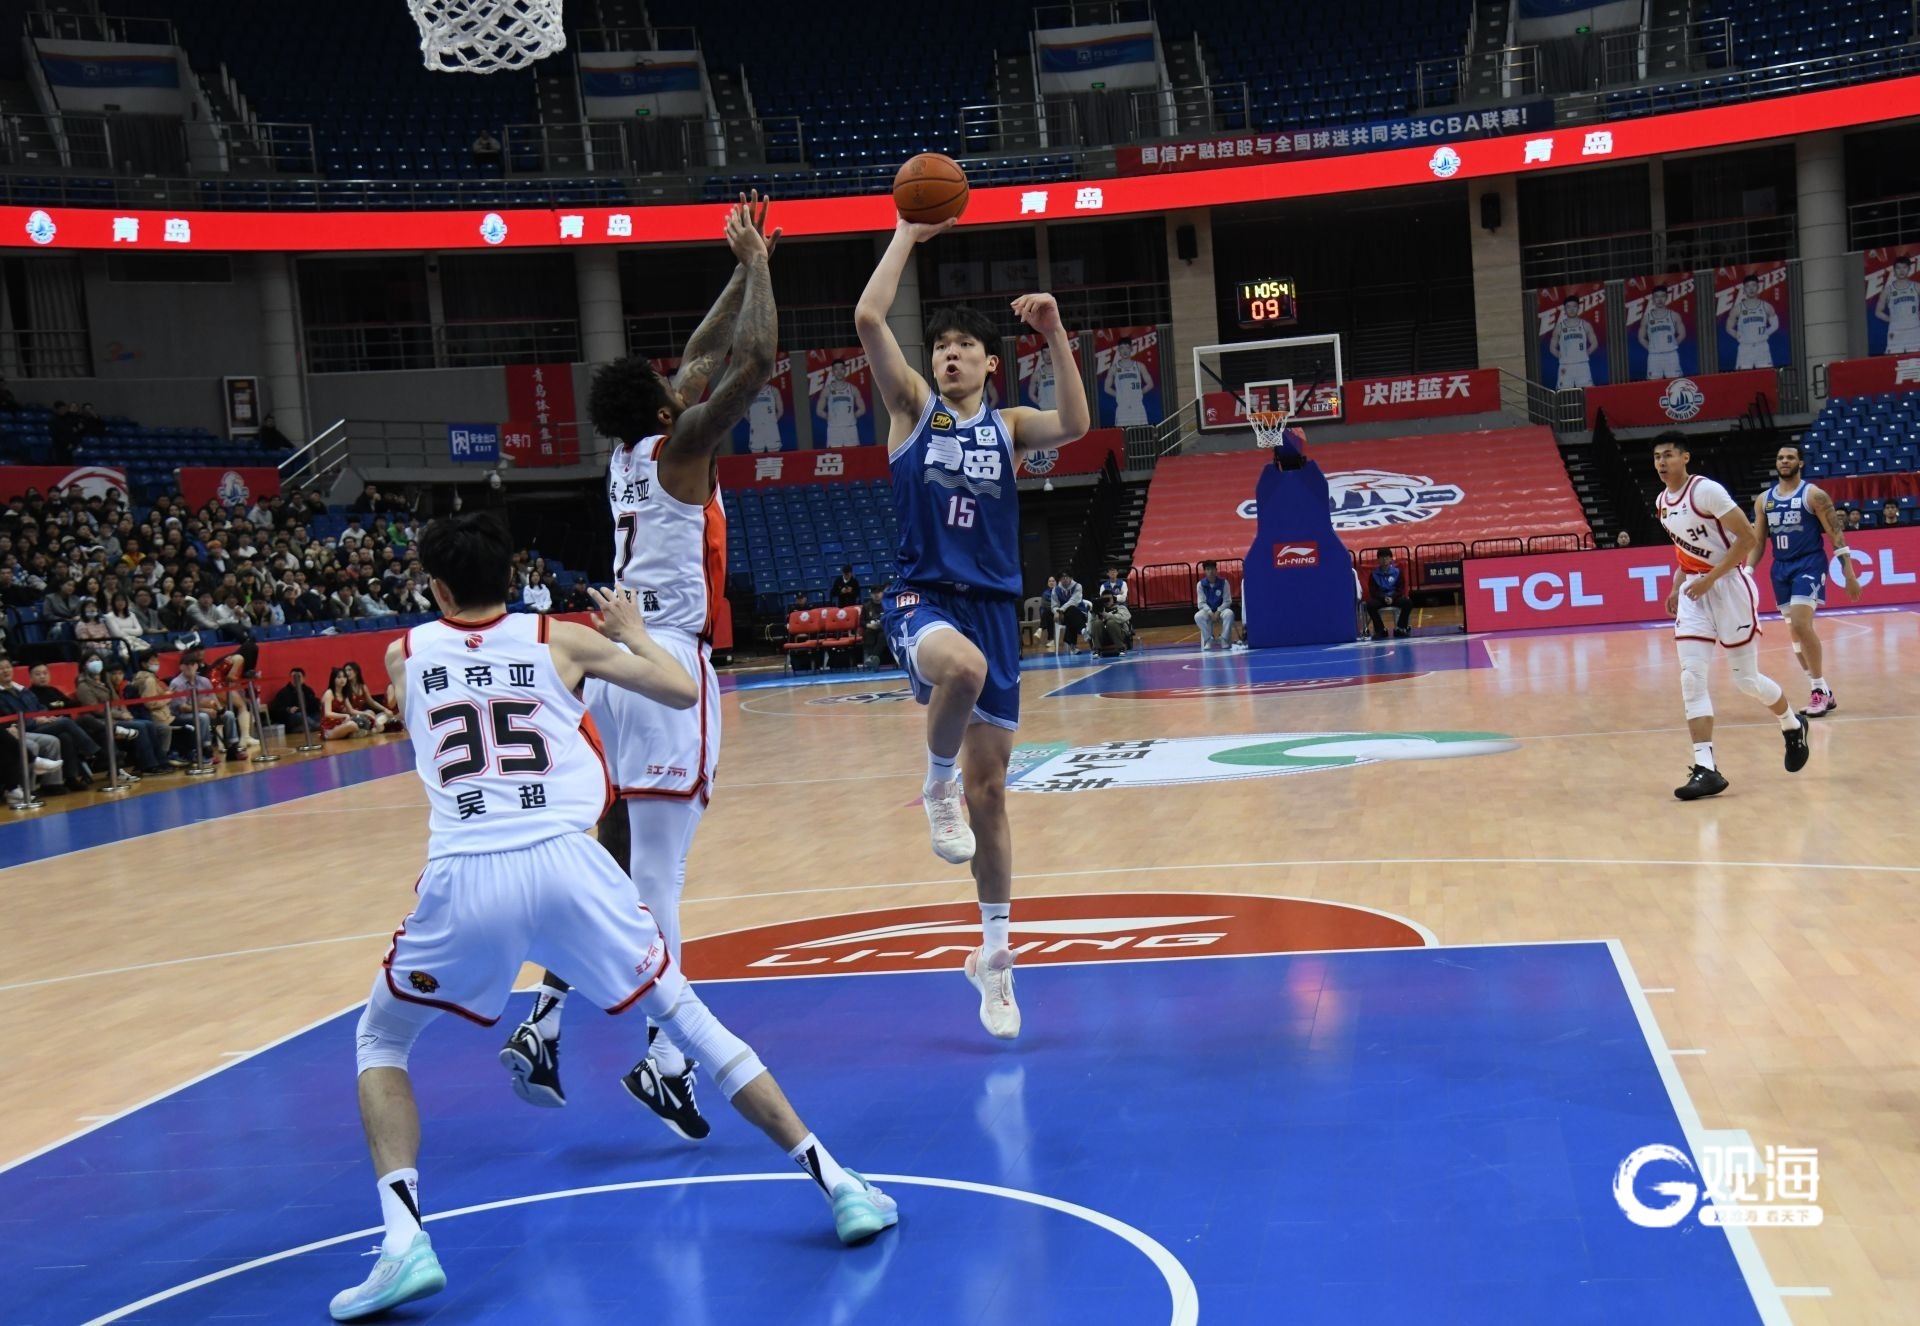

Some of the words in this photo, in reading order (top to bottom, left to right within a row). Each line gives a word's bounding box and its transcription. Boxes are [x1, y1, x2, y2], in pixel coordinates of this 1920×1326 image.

[1524, 131, 1613, 164] 青岛
[1021, 187, 1103, 214] 青岛
[113, 217, 191, 243] 青岛
[560, 214, 632, 238] 青岛
[1251, 299, 1279, 320] 09
[505, 434, 531, 448] 2号门
[755, 453, 844, 481] 青岛
[924, 435, 1001, 480] 青岛
[947, 495, 976, 529] 15
[616, 511, 638, 582] 7
[1686, 525, 1709, 542] 34
[1776, 535, 1788, 549] 10
[1277, 556, 1316, 566] LI-NING
[1829, 548, 1917, 589] CL
[1479, 571, 1603, 612] TCL
[422, 663, 535, 694] 肯帝亚
[427, 697, 553, 788] 35
[456, 783, 546, 820] 吴超
